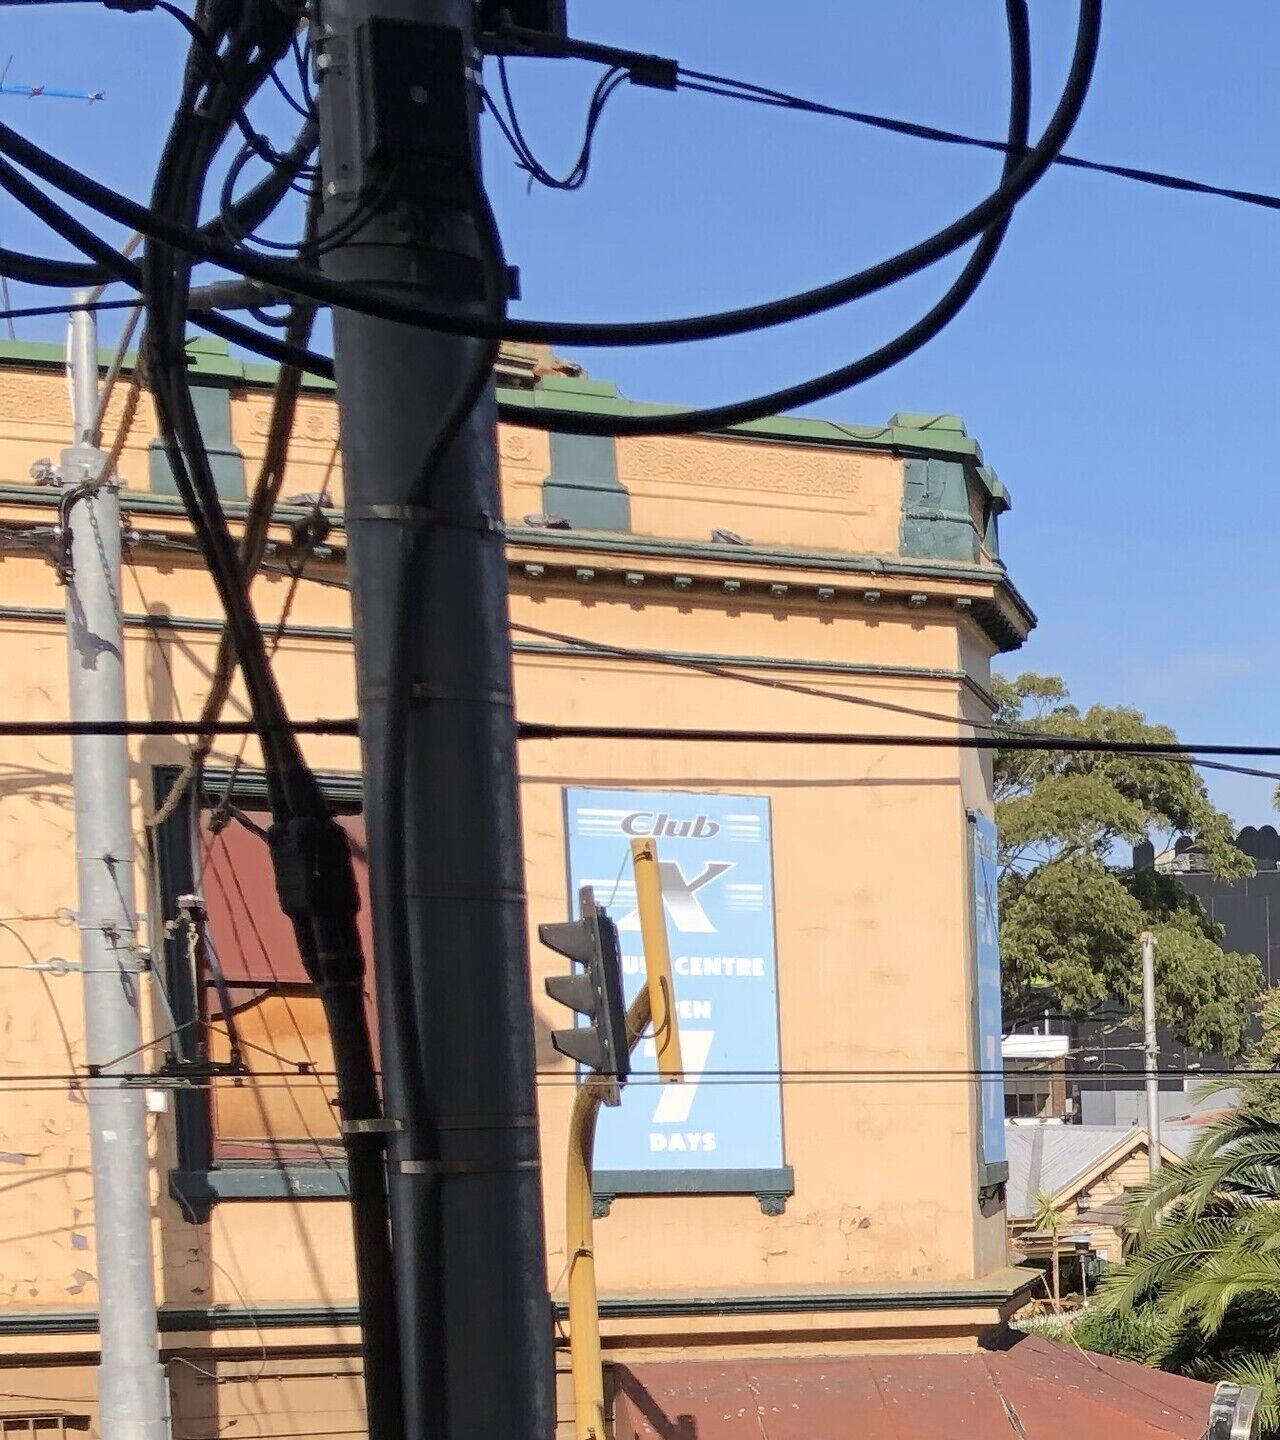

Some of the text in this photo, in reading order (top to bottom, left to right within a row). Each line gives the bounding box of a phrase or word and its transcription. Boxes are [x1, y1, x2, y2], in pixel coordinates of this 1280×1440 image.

[620, 811, 721, 839] Club
[675, 956, 766, 977] CENTRE
[649, 1131, 717, 1153] DAYS
